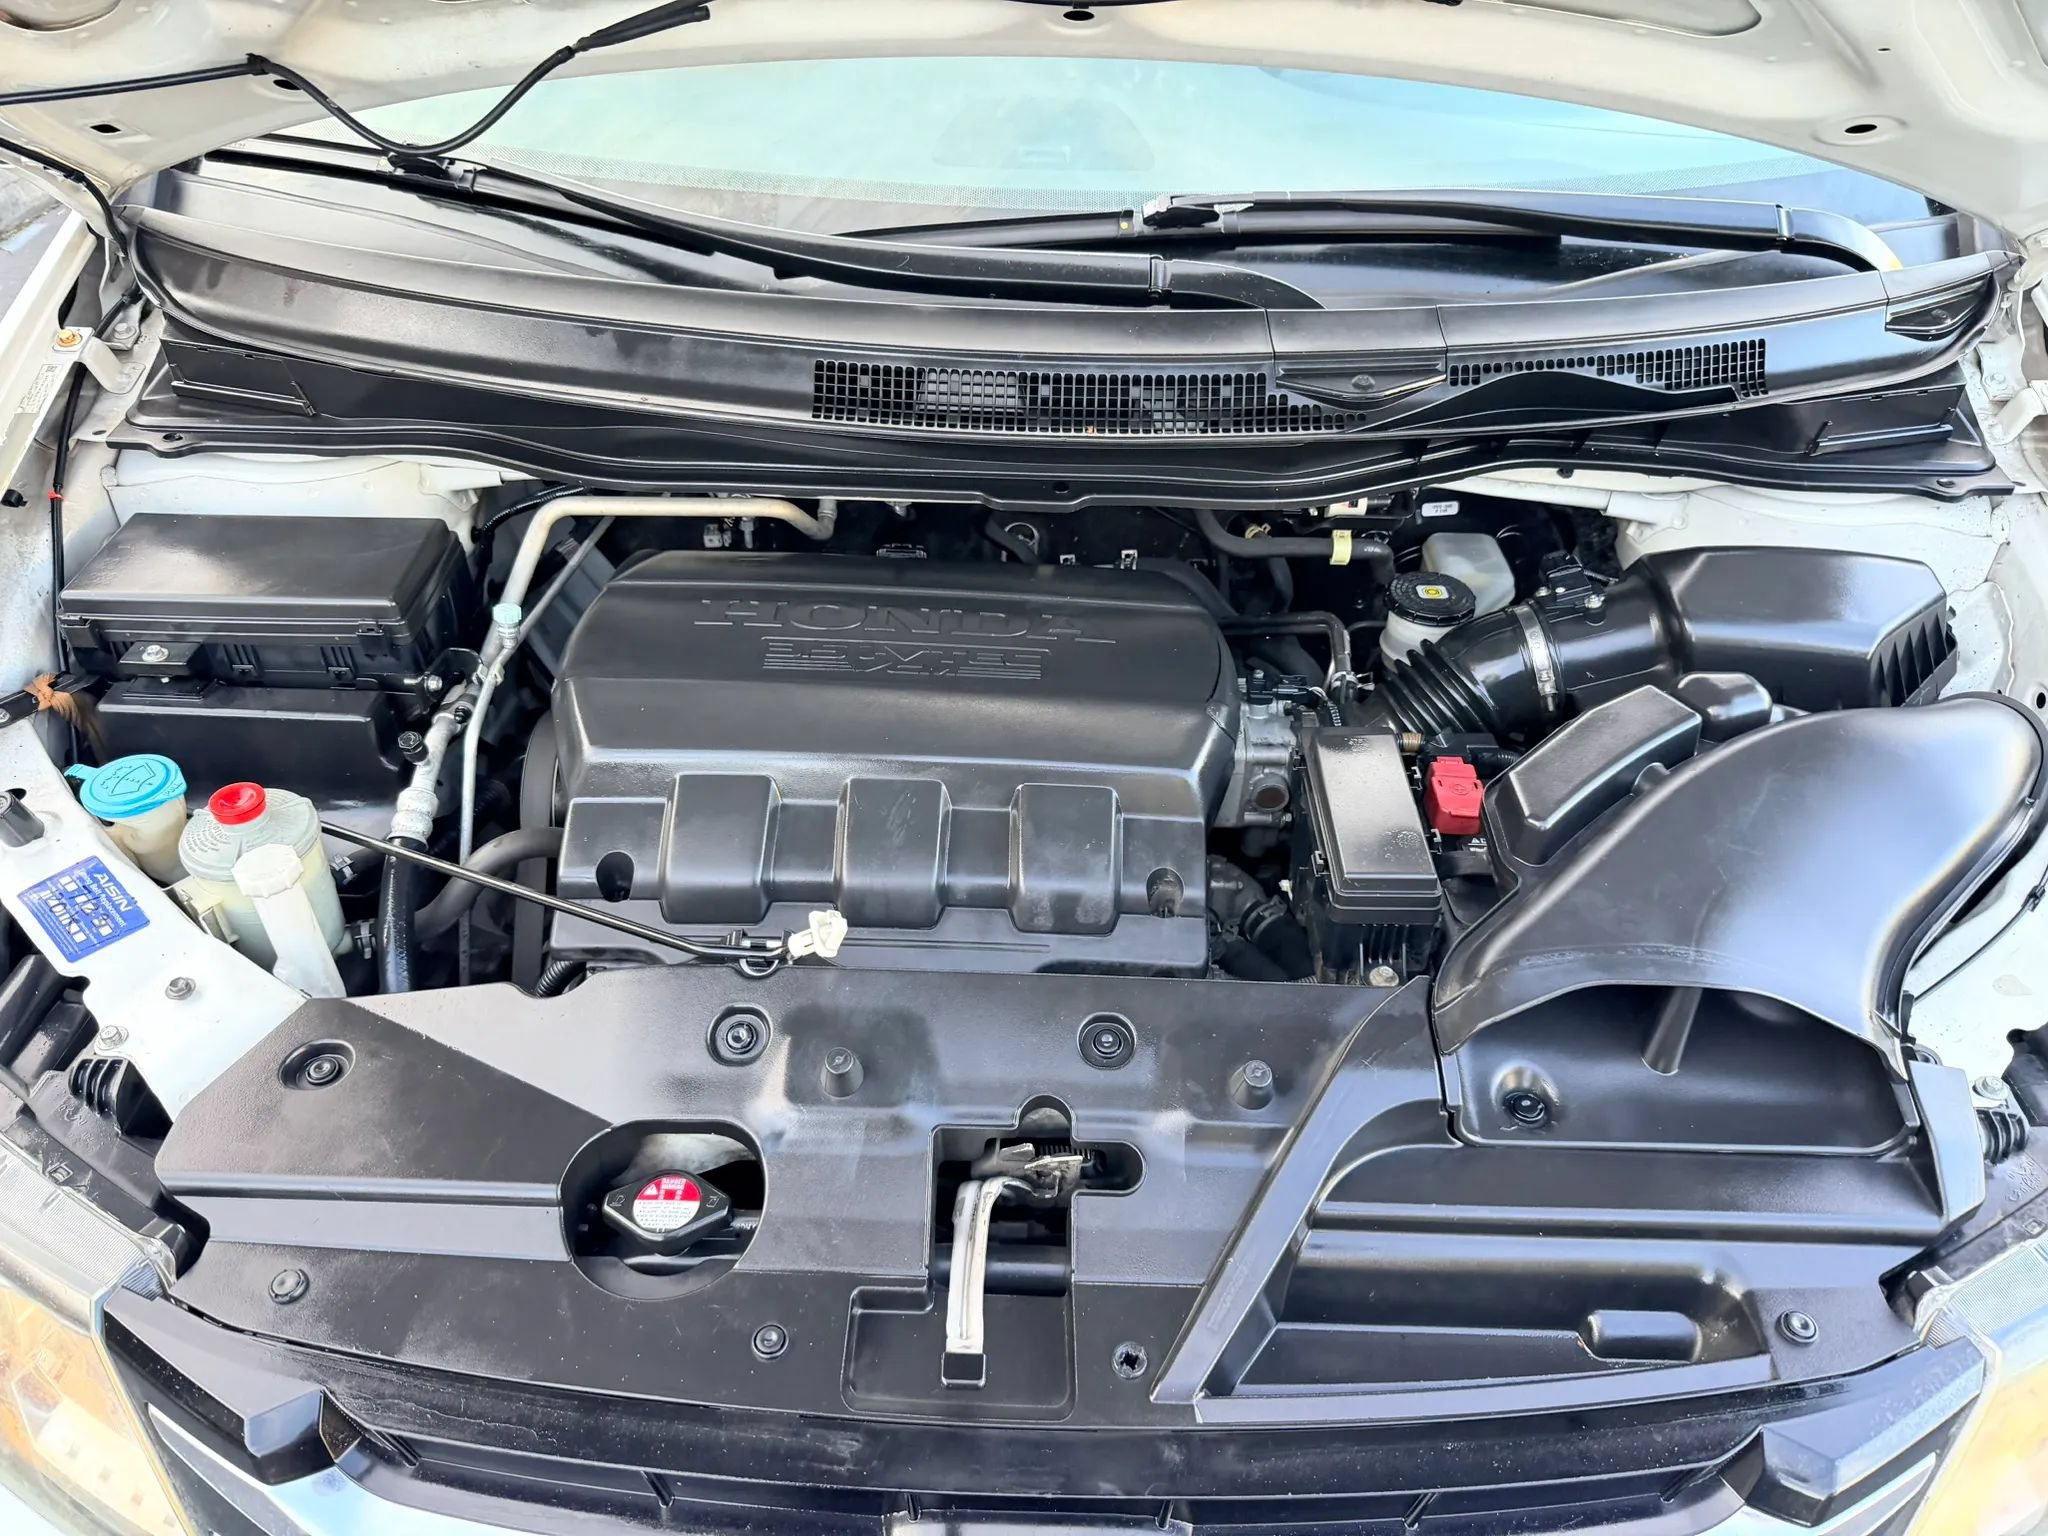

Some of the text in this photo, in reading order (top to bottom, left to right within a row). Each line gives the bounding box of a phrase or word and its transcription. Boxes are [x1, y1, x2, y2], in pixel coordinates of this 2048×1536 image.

[694, 600, 1117, 644] HONDA
[90, 882, 102, 896] Belt
[99, 893, 128, 928] Replacement
[93, 872, 133, 912] AISIN
